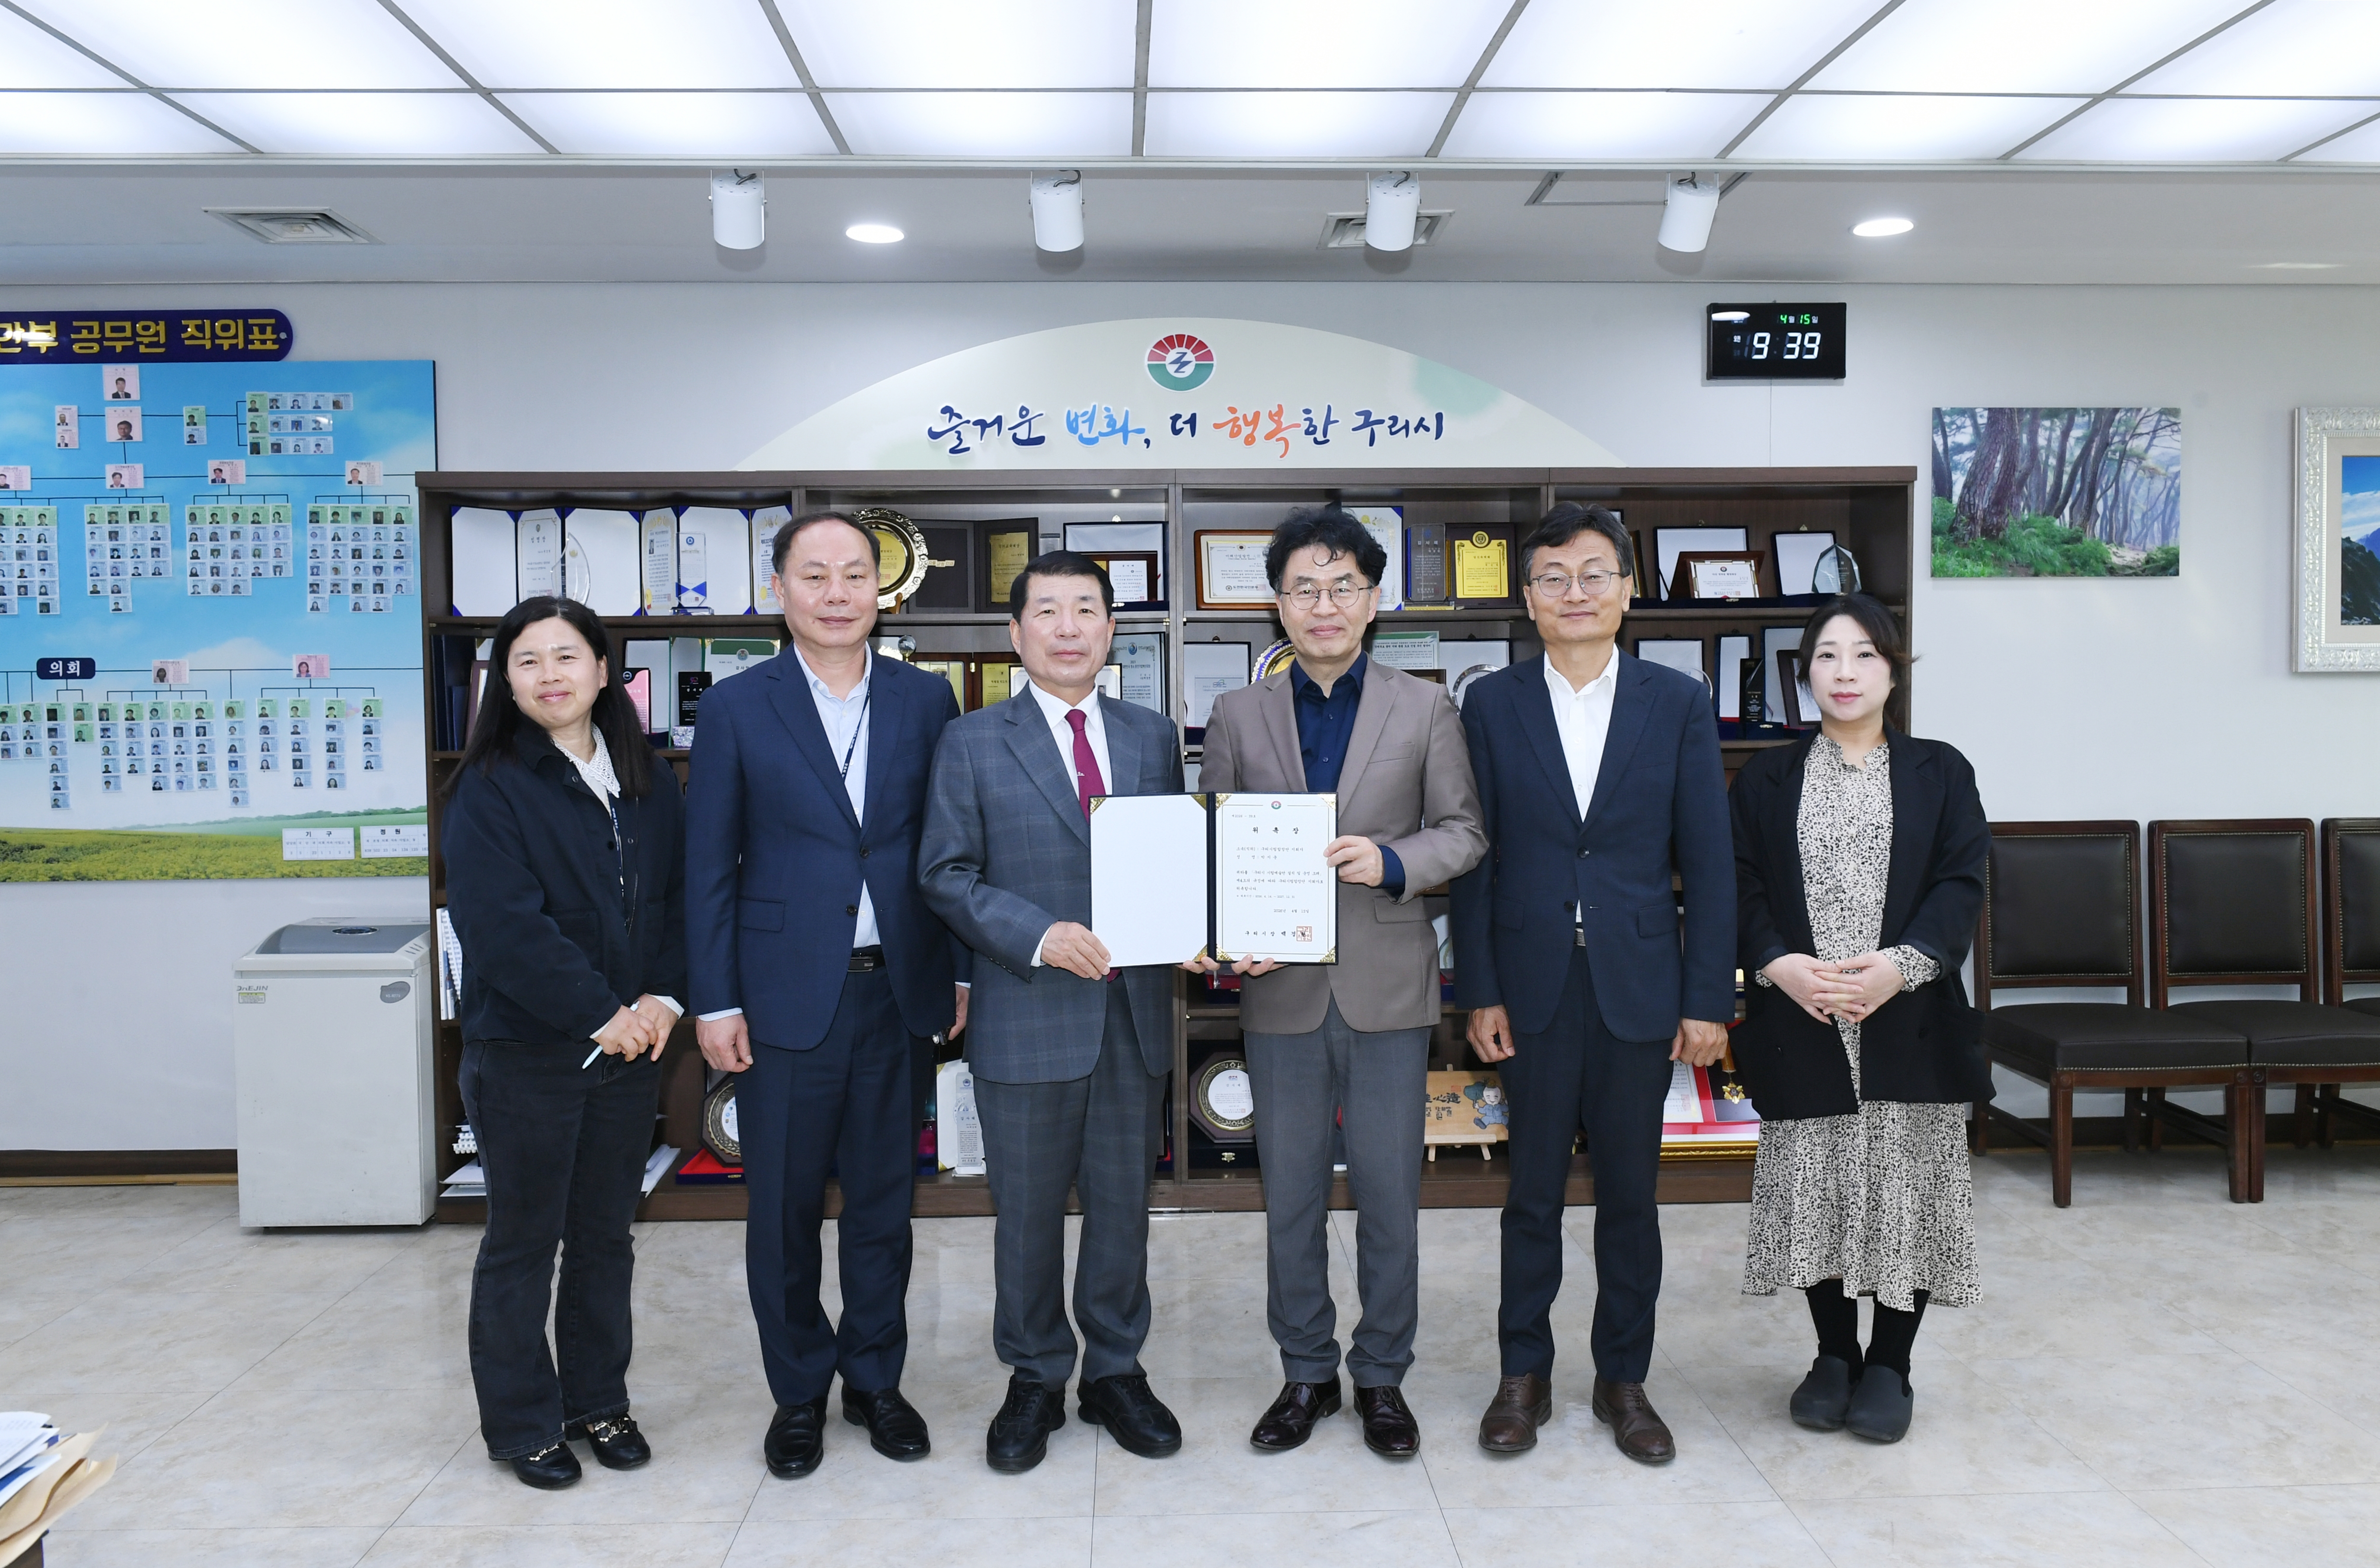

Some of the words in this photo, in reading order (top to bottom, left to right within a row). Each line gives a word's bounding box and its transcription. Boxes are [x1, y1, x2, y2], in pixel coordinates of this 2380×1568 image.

[70, 320, 166, 353] 공무원
[181, 319, 279, 350] 직위표
[927, 405, 1045, 454] 즐거운
[1066, 404, 1150, 449] 변화,
[1170, 413, 1196, 437] 더
[1213, 404, 1340, 458] 행복한
[1351, 410, 1443, 447] 구리시
[49, 660, 80, 677] 의회
